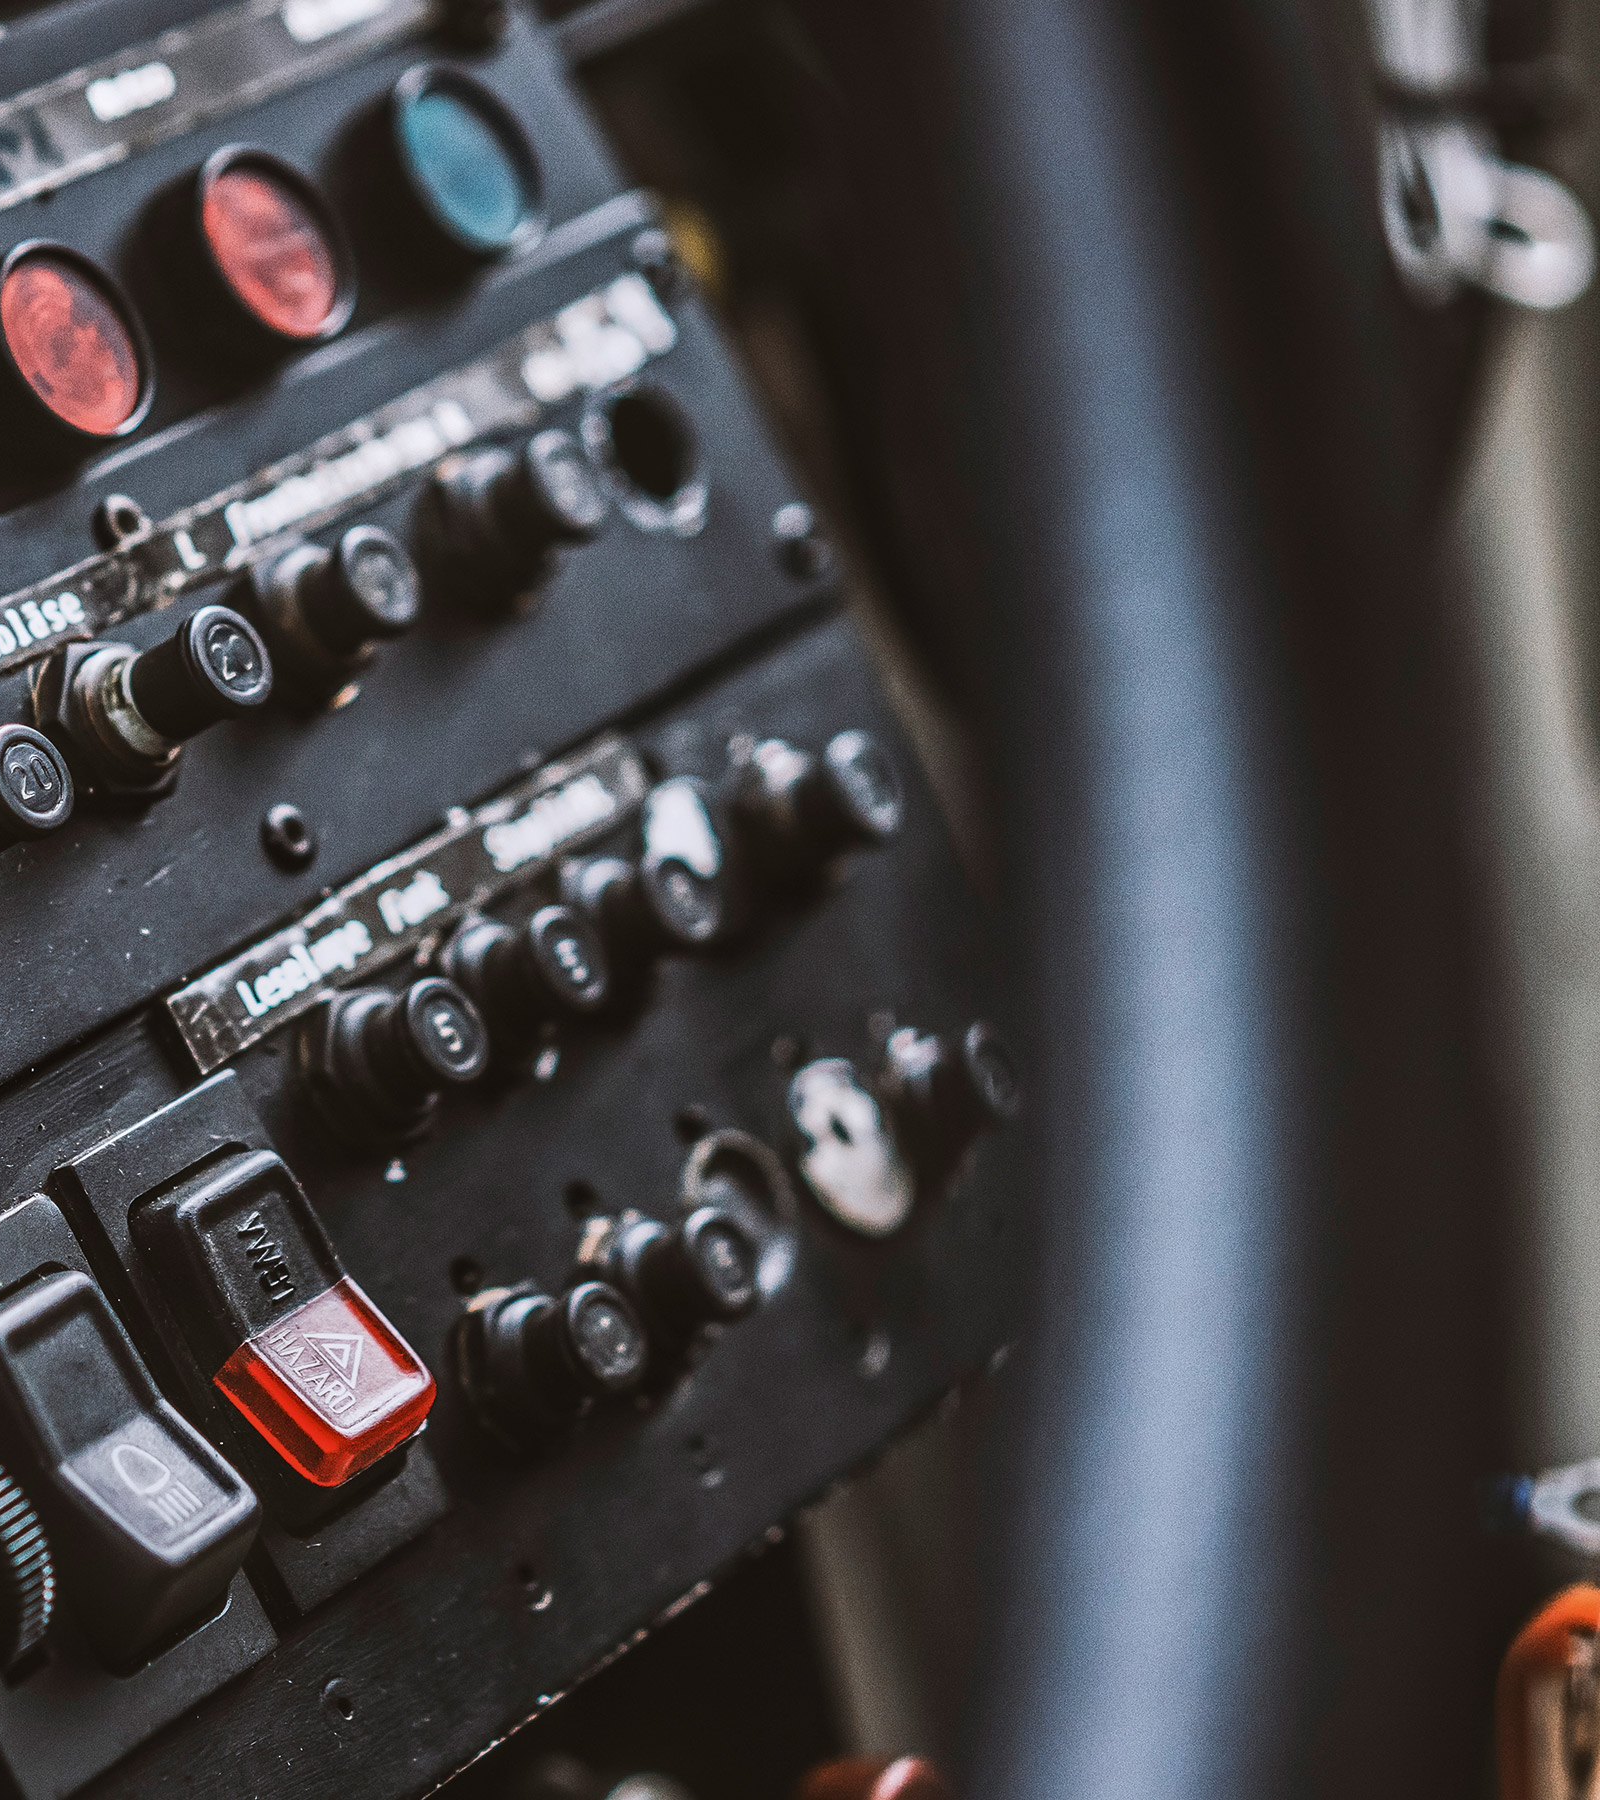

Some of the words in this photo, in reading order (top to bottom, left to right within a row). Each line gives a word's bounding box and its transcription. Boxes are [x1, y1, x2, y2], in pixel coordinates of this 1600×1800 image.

[8, 753, 54, 801] 20
[433, 1012, 464, 1053] 5
[267, 1327, 357, 1415] HAZARD
